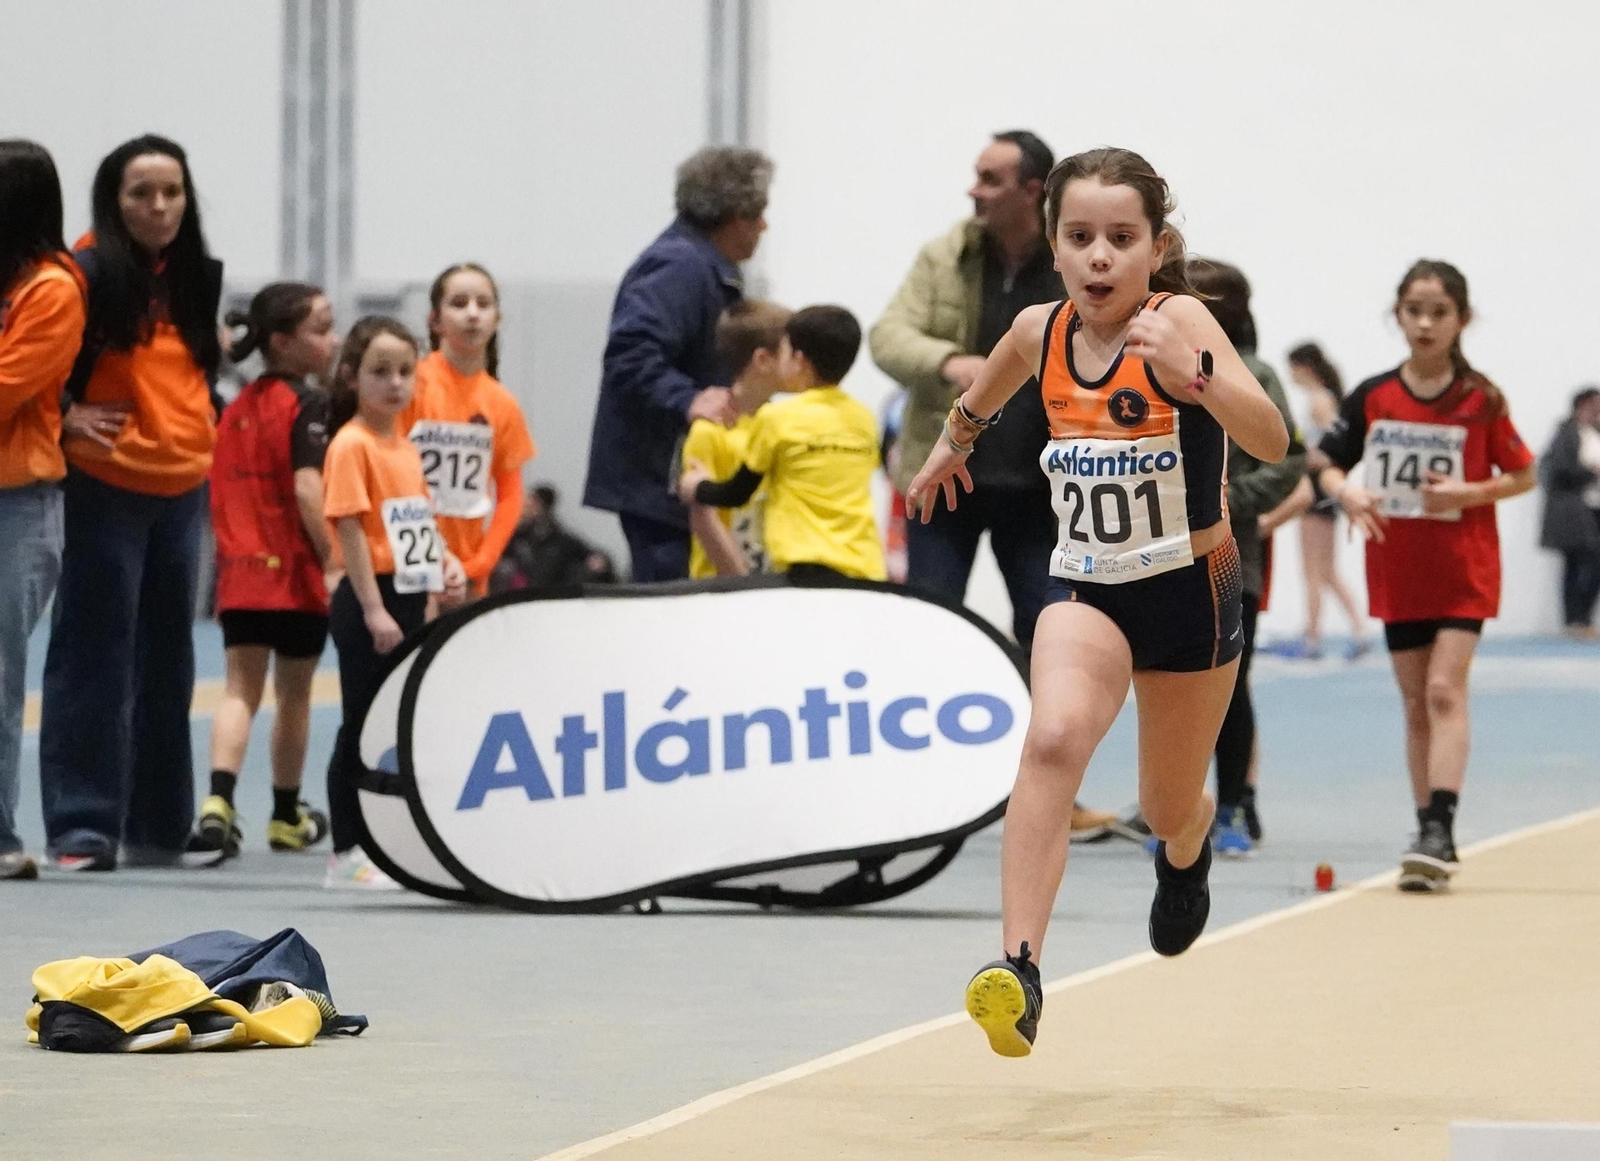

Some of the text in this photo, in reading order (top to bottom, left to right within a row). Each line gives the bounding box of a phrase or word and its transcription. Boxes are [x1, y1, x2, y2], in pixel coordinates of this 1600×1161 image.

[421, 449, 482, 490] 212
[1048, 445, 1178, 477] Atlántico
[1063, 479, 1164, 544] 201
[399, 527, 438, 566] 22
[1094, 558, 1119, 567] XUNTA
[1094, 564, 1138, 574] DE GALICIA
[455, 670, 1014, 811] Atlántico
